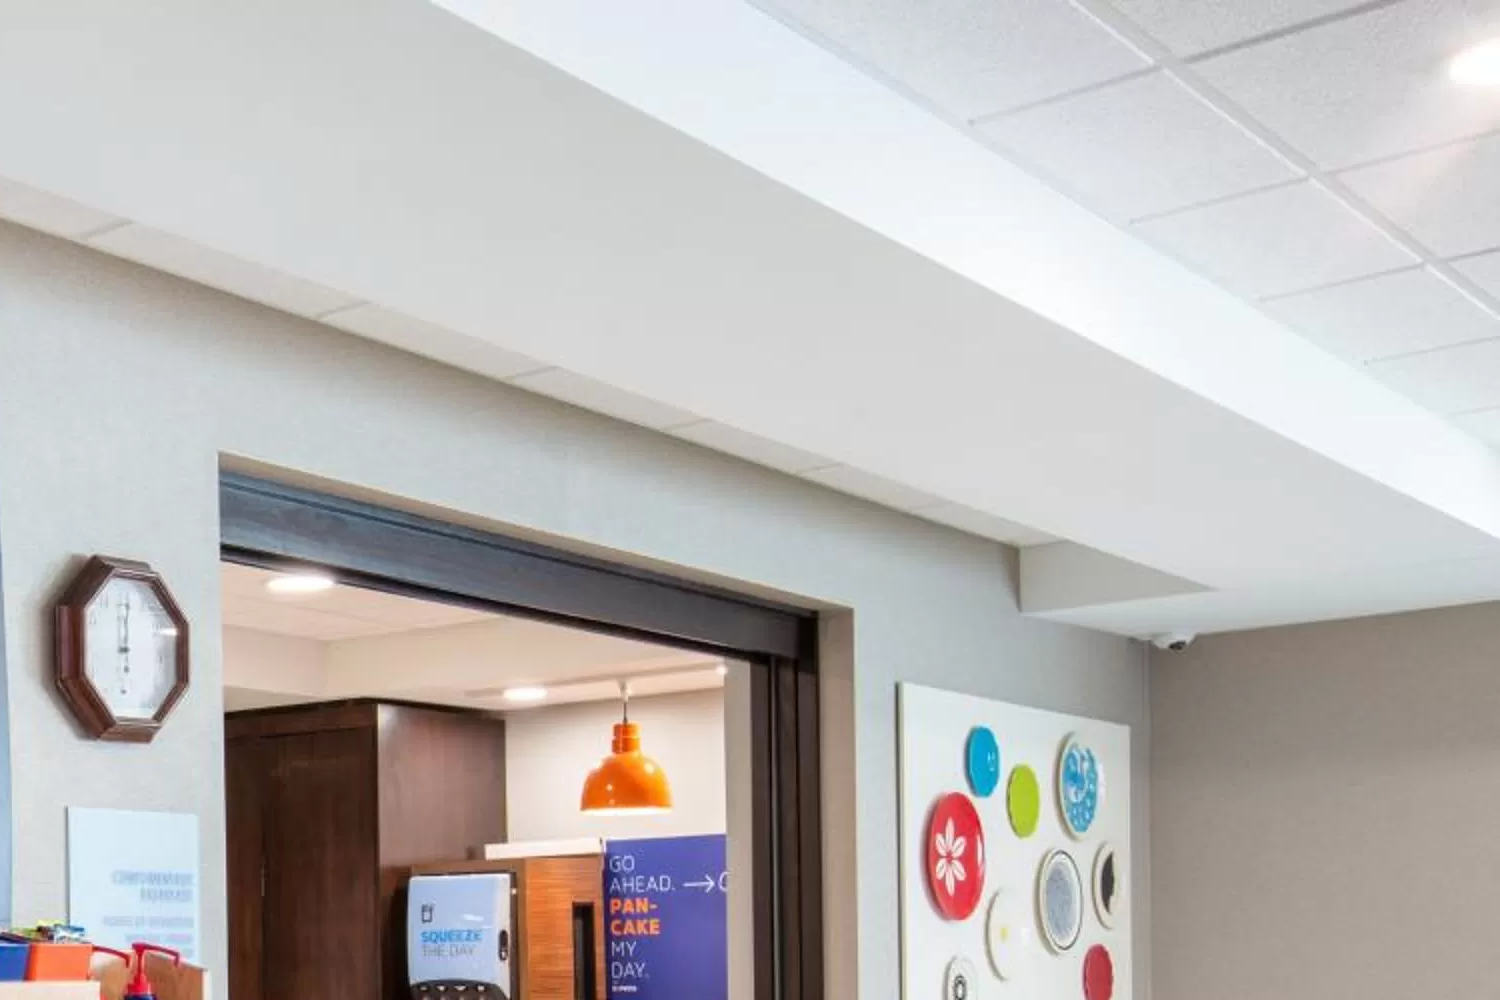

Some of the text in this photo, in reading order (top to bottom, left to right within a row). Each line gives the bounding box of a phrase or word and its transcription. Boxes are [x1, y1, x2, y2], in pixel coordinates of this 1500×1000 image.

[609, 854, 635, 872] GO
[609, 875, 676, 894] AHEAD.
[610, 897, 658, 914] PAN-
[420, 928, 483, 944] SQUEEZE
[610, 919, 660, 936] CAKE
[421, 943, 476, 957] THE DAY
[611, 941, 637, 957] MY
[611, 961, 649, 979] DAY.
